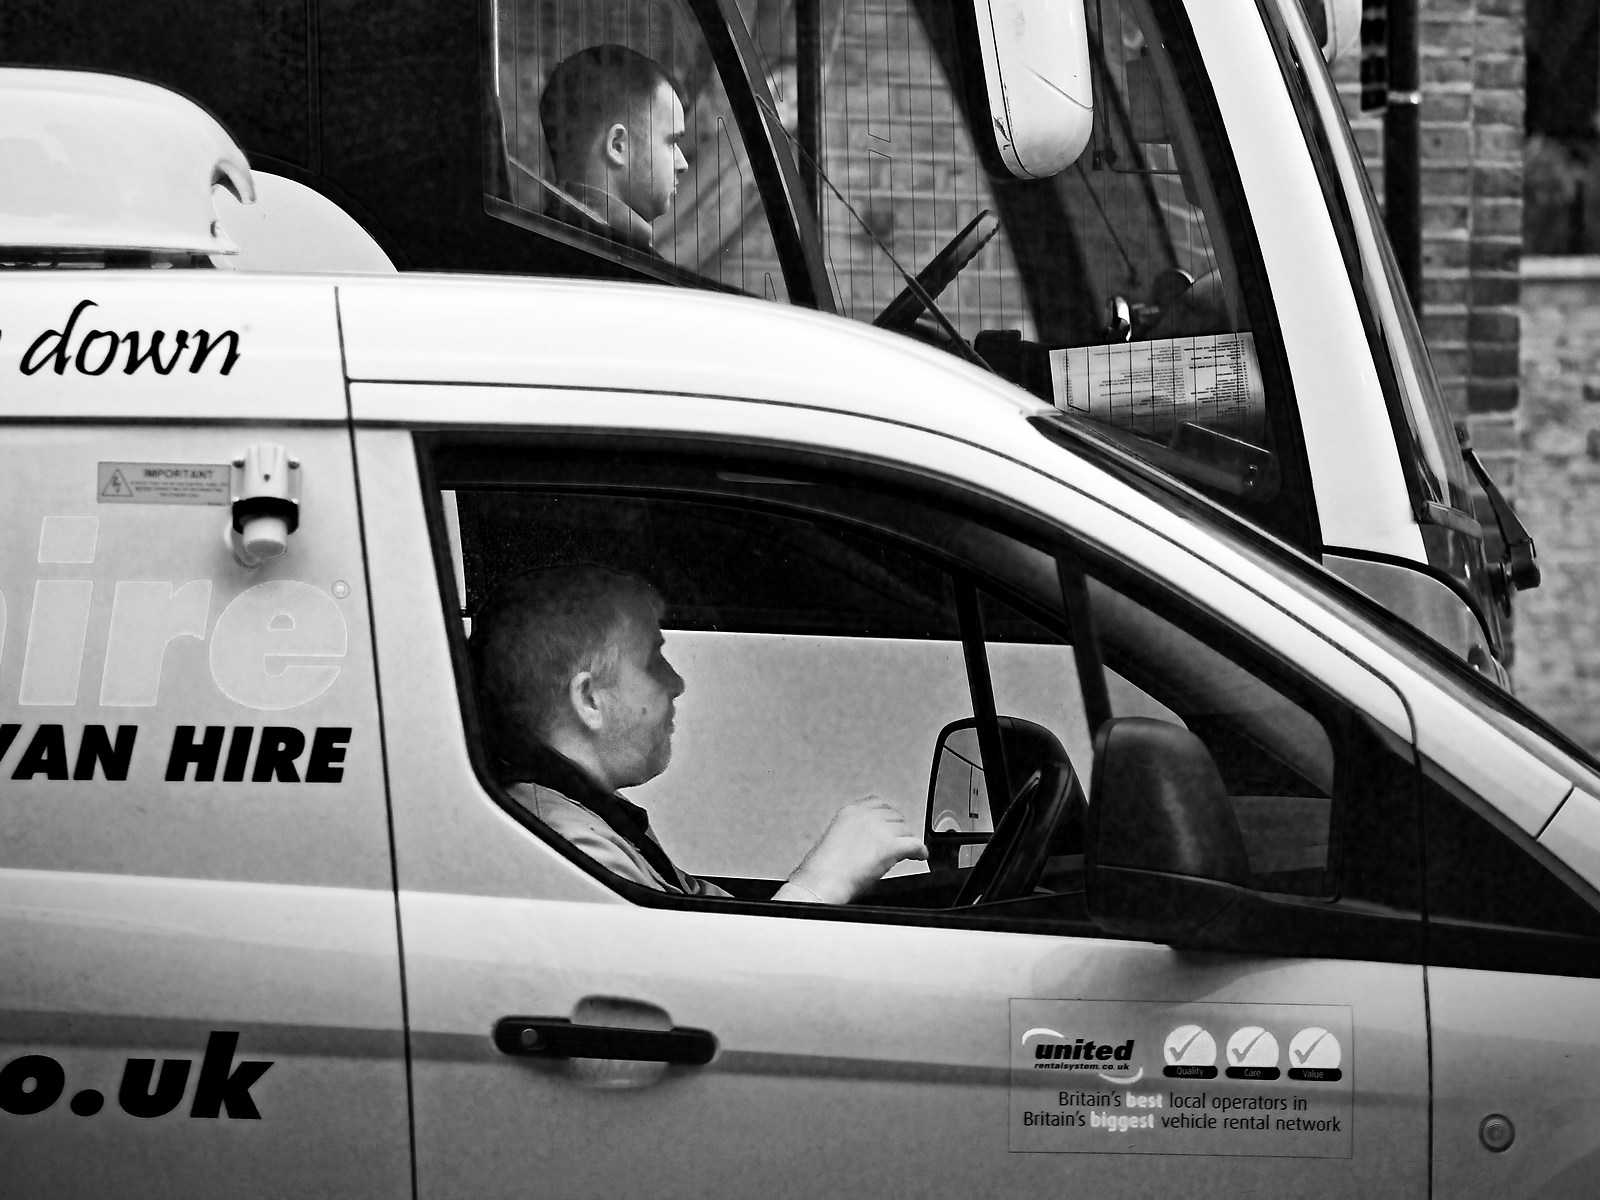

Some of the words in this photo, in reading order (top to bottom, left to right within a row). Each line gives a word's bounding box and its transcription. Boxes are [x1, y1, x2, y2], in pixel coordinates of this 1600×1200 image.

[19, 299, 242, 377] down
[165, 725, 353, 783] HIRE
[1034, 1038, 1135, 1061] united
[1176, 1067, 1204, 1077] Quality
[1244, 1068, 1262, 1077] Care
[1302, 1069, 1324, 1079] Value
[1059, 1090, 1121, 1107] Britain's
[1125, 1091, 1163, 1108] best
[1169, 1092, 1206, 1109] local
[1212, 1095, 1288, 1112] operators
[1293, 1095, 1307, 1110] in
[1024, 1111, 1086, 1127] Britain's
[1090, 1111, 1155, 1132] biggest
[1162, 1113, 1217, 1129] vehicle
[1224, 1114, 1270, 1130] rental
[1276, 1116, 1341, 1132] network
